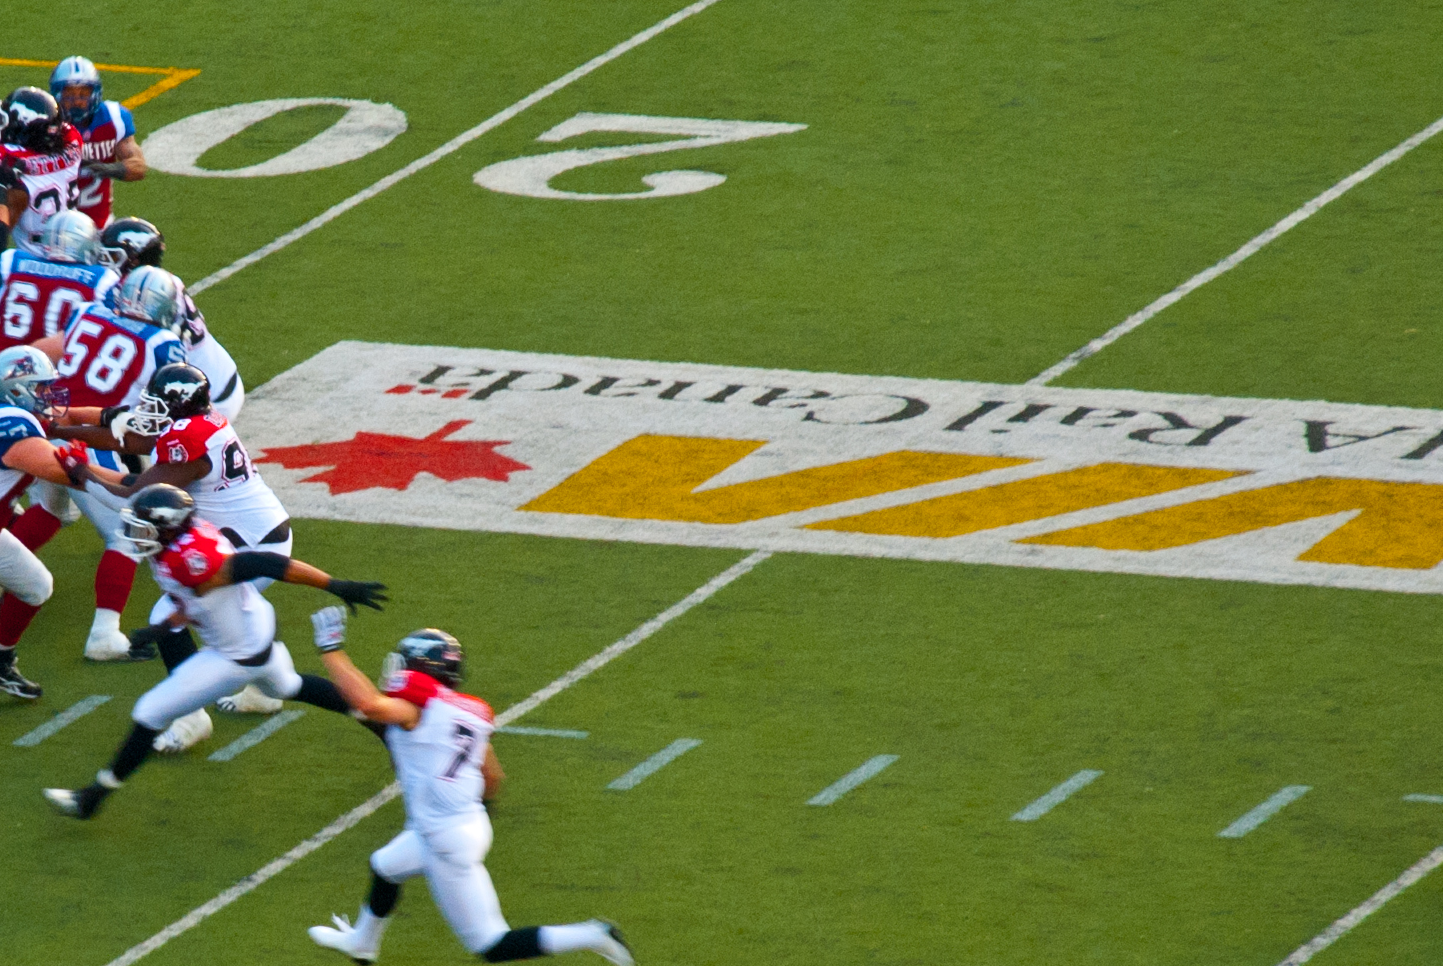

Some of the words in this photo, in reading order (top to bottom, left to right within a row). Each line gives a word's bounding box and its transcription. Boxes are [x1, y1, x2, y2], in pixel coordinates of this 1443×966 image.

[3, 281, 85, 340] 60
[57, 319, 137, 394] 58
[419, 364, 931, 425] Canada
[943, 400, 1253, 447] Rail
